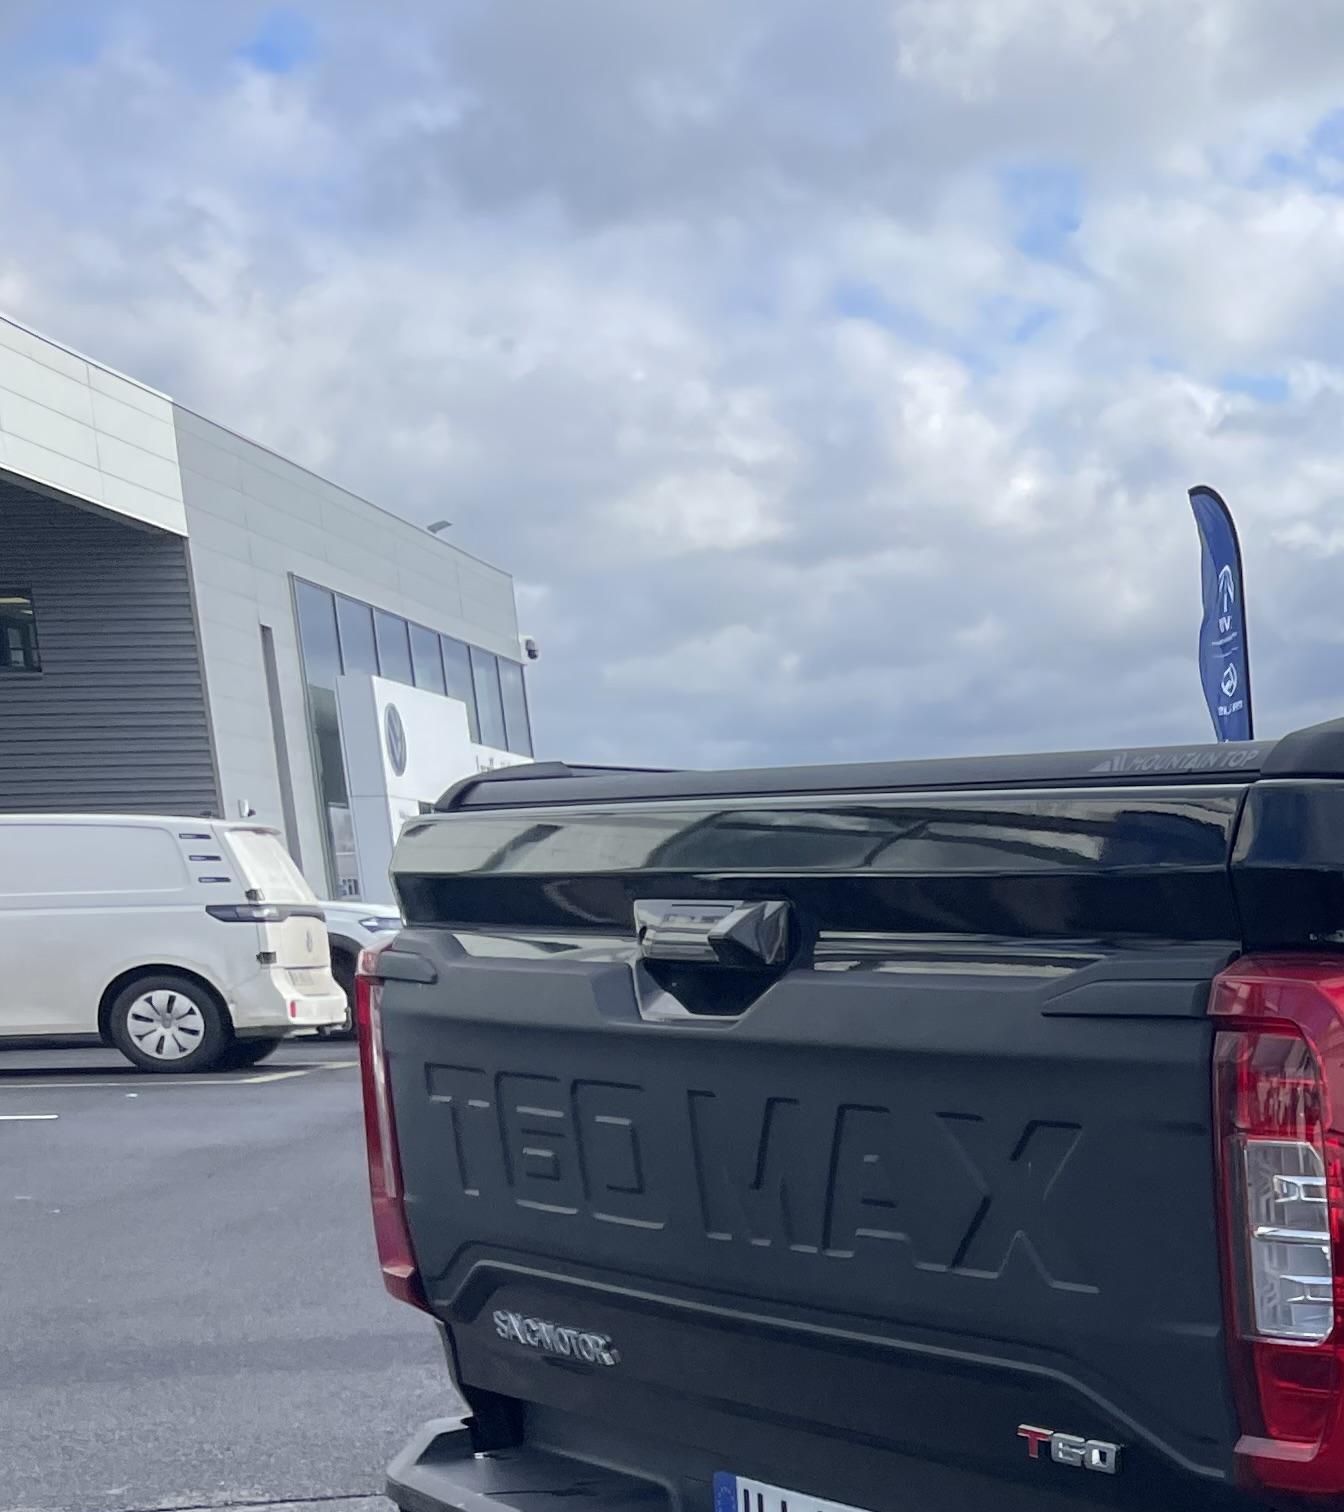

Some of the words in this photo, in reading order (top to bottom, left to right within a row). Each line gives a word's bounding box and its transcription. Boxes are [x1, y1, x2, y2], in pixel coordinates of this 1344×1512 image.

[1124, 751, 1217, 772] MOUNTAIN
[1219, 749, 1259, 769] TOP
[687, 1089, 1100, 1293] MAX
[1017, 1423, 1120, 1474] T60
